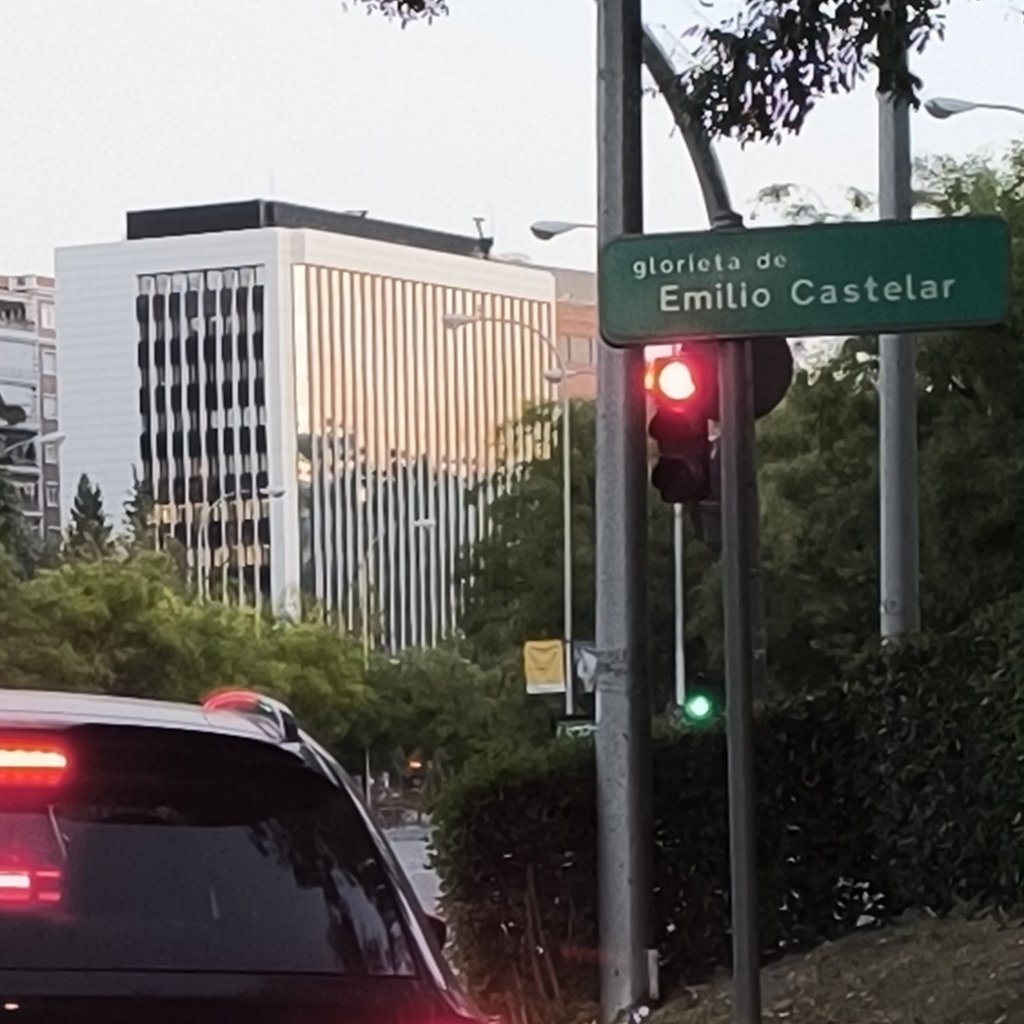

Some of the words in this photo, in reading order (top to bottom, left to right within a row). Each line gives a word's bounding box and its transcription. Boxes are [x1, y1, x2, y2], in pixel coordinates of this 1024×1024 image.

[632, 252, 741, 280] glorieta
[756, 252, 787, 270] de
[659, 280, 771, 312] Emilio
[790, 273, 956, 306] Castelar
